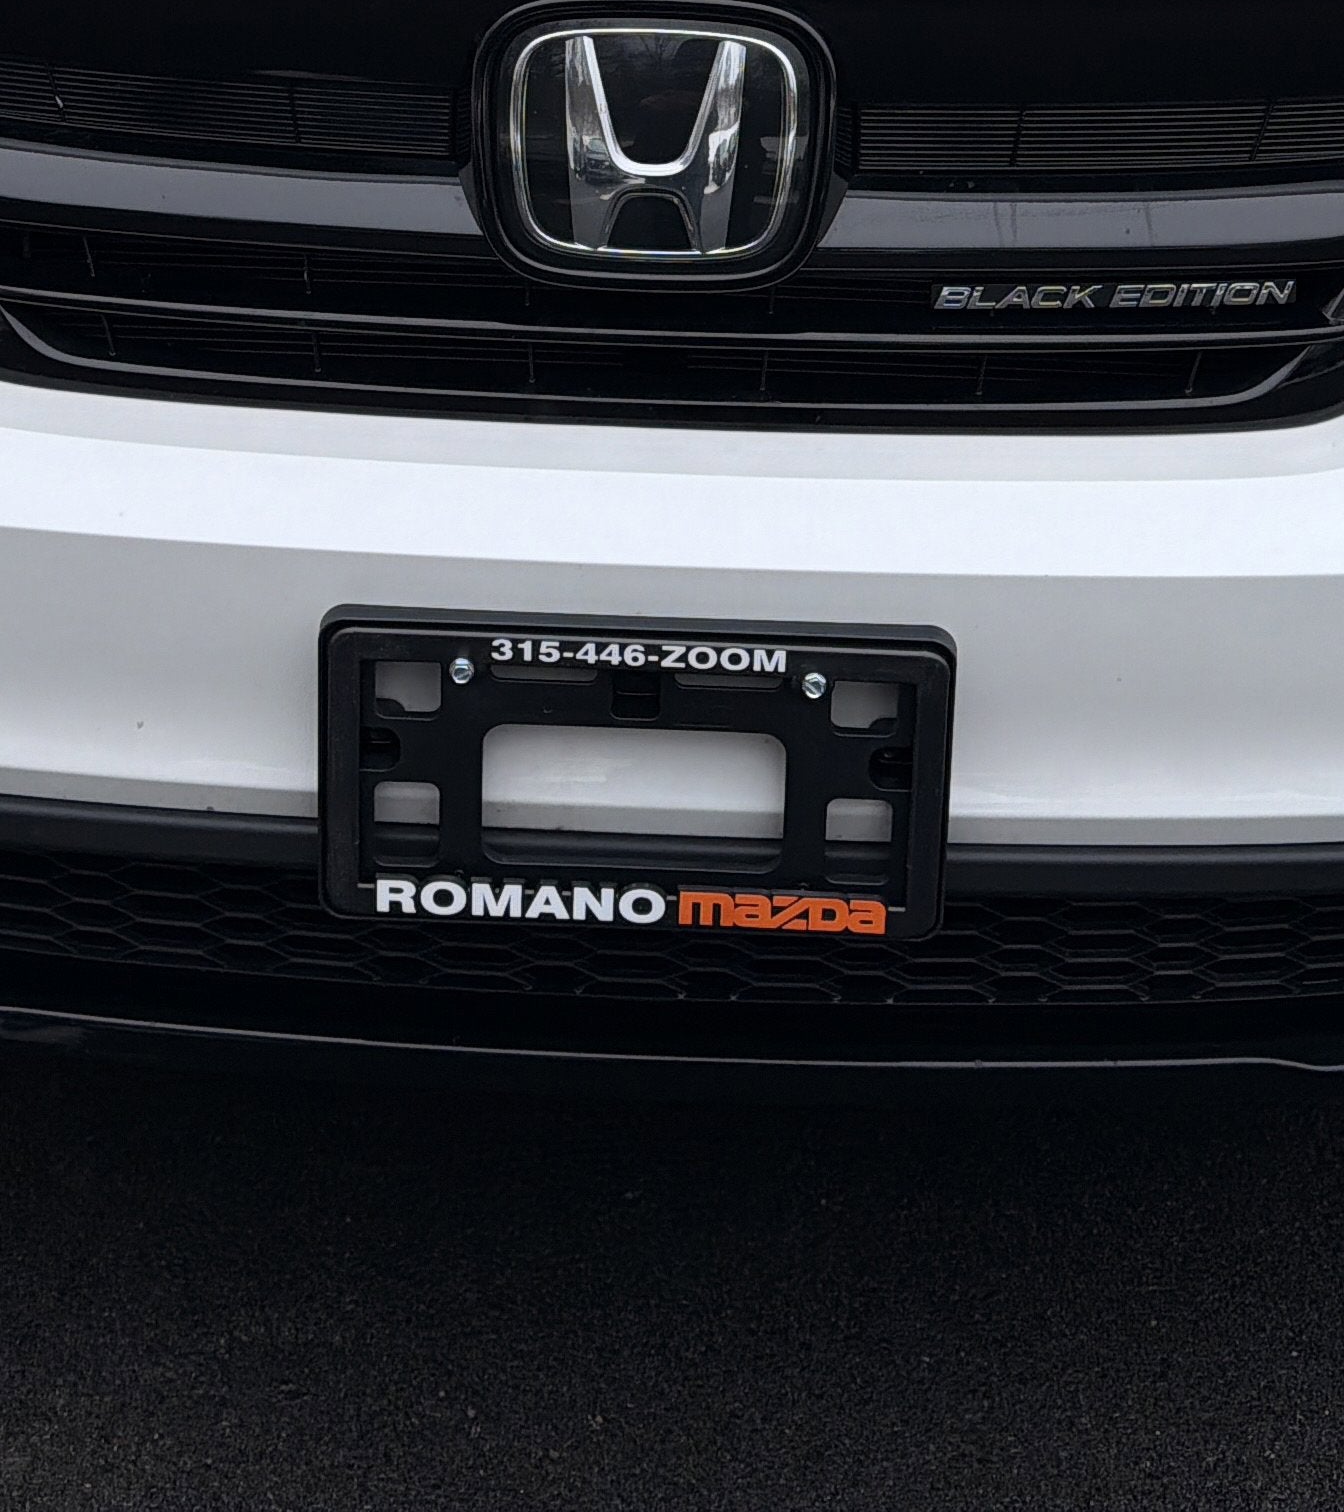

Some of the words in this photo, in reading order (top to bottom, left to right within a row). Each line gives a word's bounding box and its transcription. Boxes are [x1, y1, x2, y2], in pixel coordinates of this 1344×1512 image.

[933, 284, 1103, 310] BLACK
[1109, 280, 1296, 309] EDITION
[490, 638, 787, 673] 315-446-ZOOM
[375, 878, 666, 924] ROMANO
